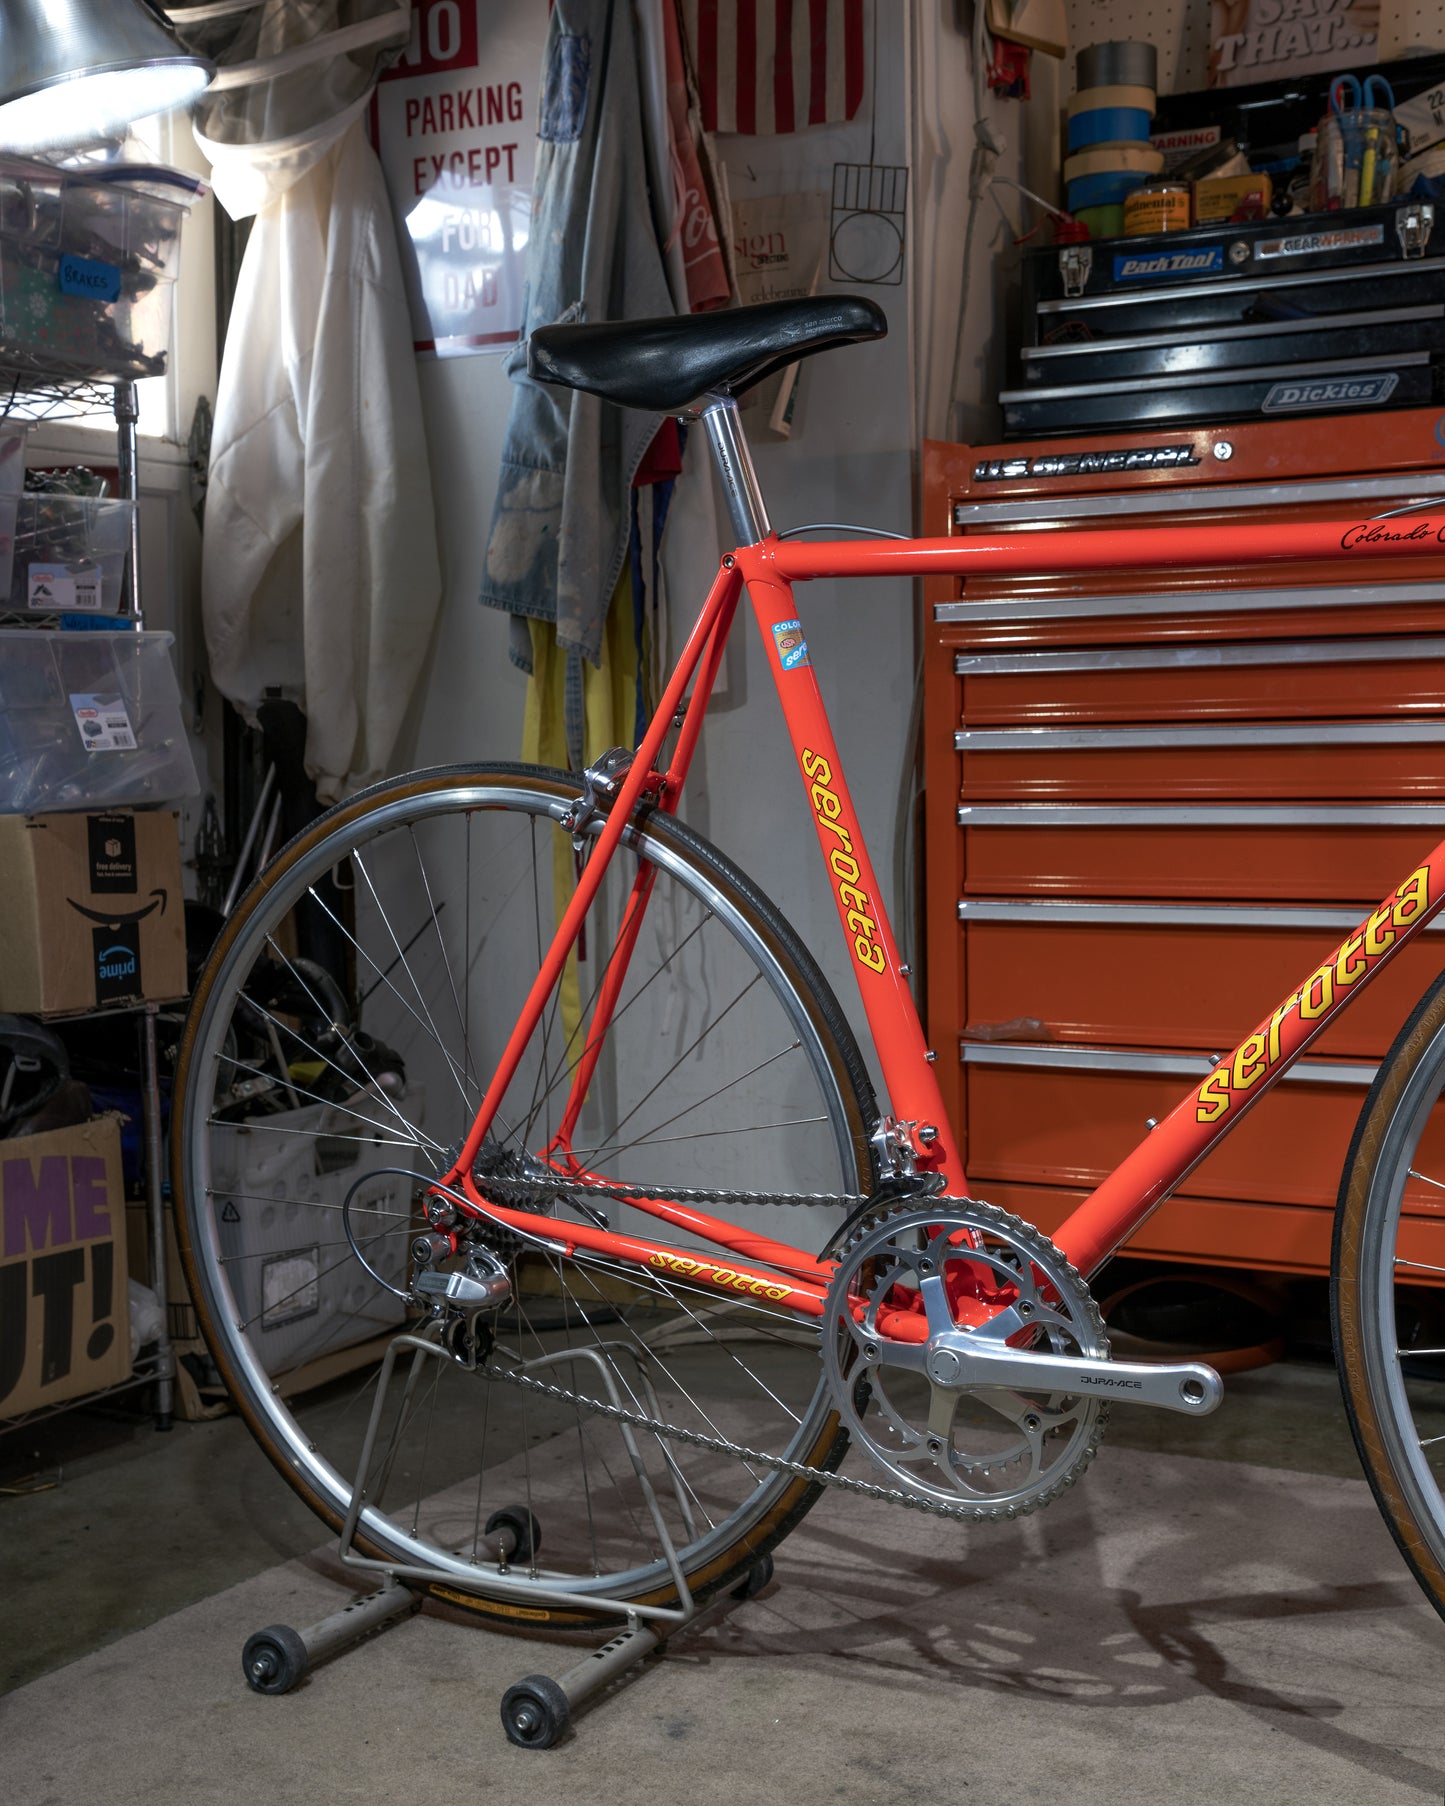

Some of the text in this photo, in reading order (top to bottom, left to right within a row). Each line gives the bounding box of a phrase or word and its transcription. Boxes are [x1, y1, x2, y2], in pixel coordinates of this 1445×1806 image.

[1215, 15, 1377, 72] THAT...
[405, 82, 523, 137] PARKING
[413, 144, 518, 197] EXCEPT
[443, 209, 494, 253] FOR
[64, 263, 108, 289] BRAKES
[443, 268, 498, 313] DAD
[1278, 383, 1377, 404] Dickies
[1341, 523, 1436, 550] Colorado
[801, 748, 887, 975] serotta
[99, 956, 136, 980] prime
[1196, 865, 1430, 1122] serotta
[649, 1251, 793, 1300] serotta
[1080, 1376, 1143, 1389] DURA-ACE
